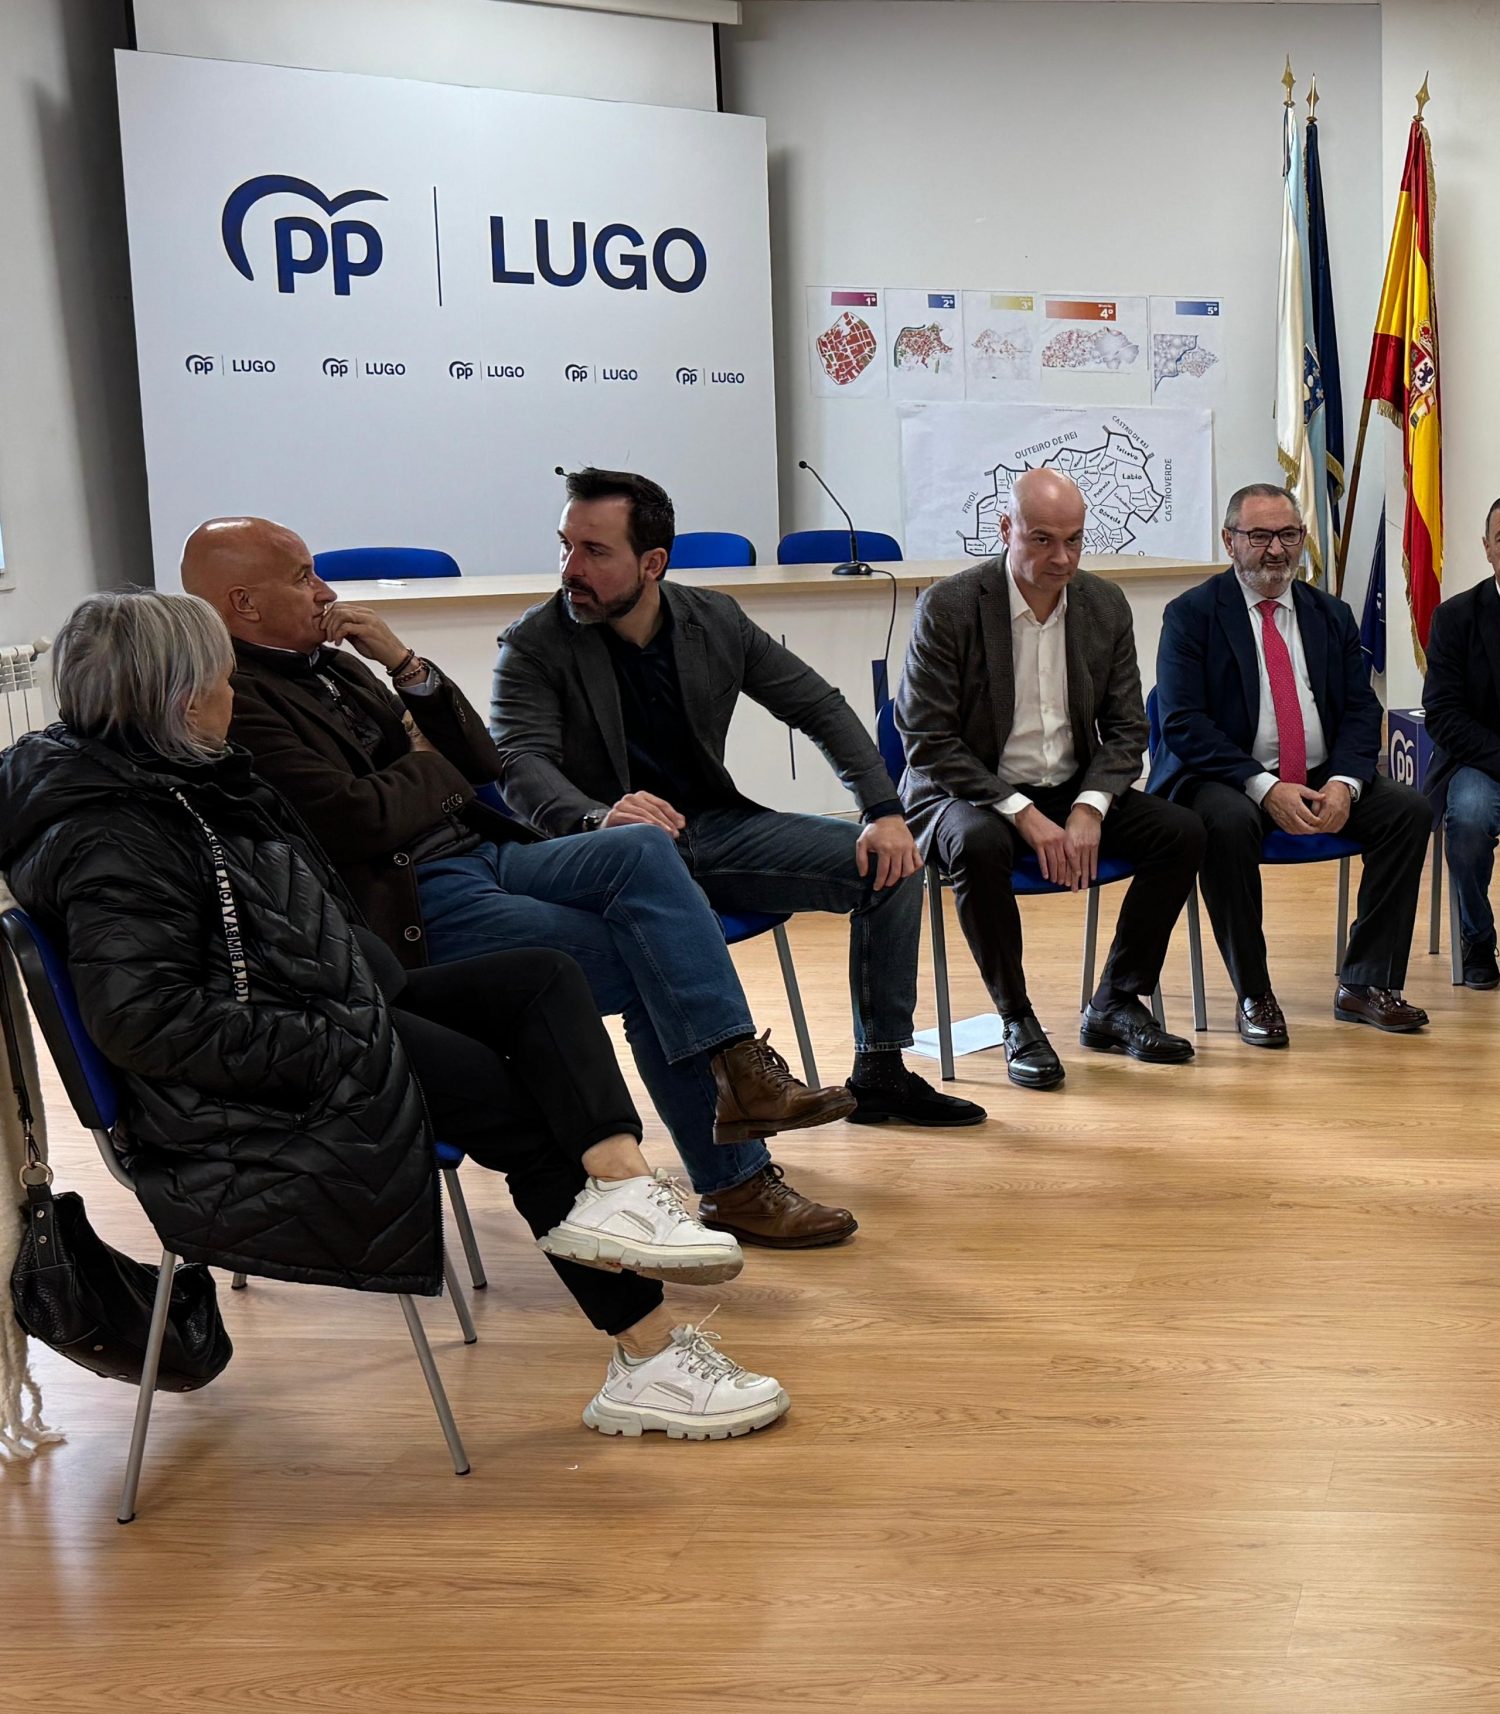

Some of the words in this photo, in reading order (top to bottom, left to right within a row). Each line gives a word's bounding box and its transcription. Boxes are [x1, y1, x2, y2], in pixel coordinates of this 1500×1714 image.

[490, 216, 707, 293] LUGO
[233, 359, 276, 373] LUGO
[366, 362, 406, 376] LUGO
[487, 365, 525, 378] LUGO
[603, 368, 638, 381] LUGO
[711, 371, 745, 384] LUGO
[1112, 415, 1133, 438] CASTRO
[1015, 440, 1051, 460] OUTEIRO
[1052, 436, 1063, 447] DE
[1065, 431, 1078, 443] REI
[962, 491, 978, 514] FRIOL
